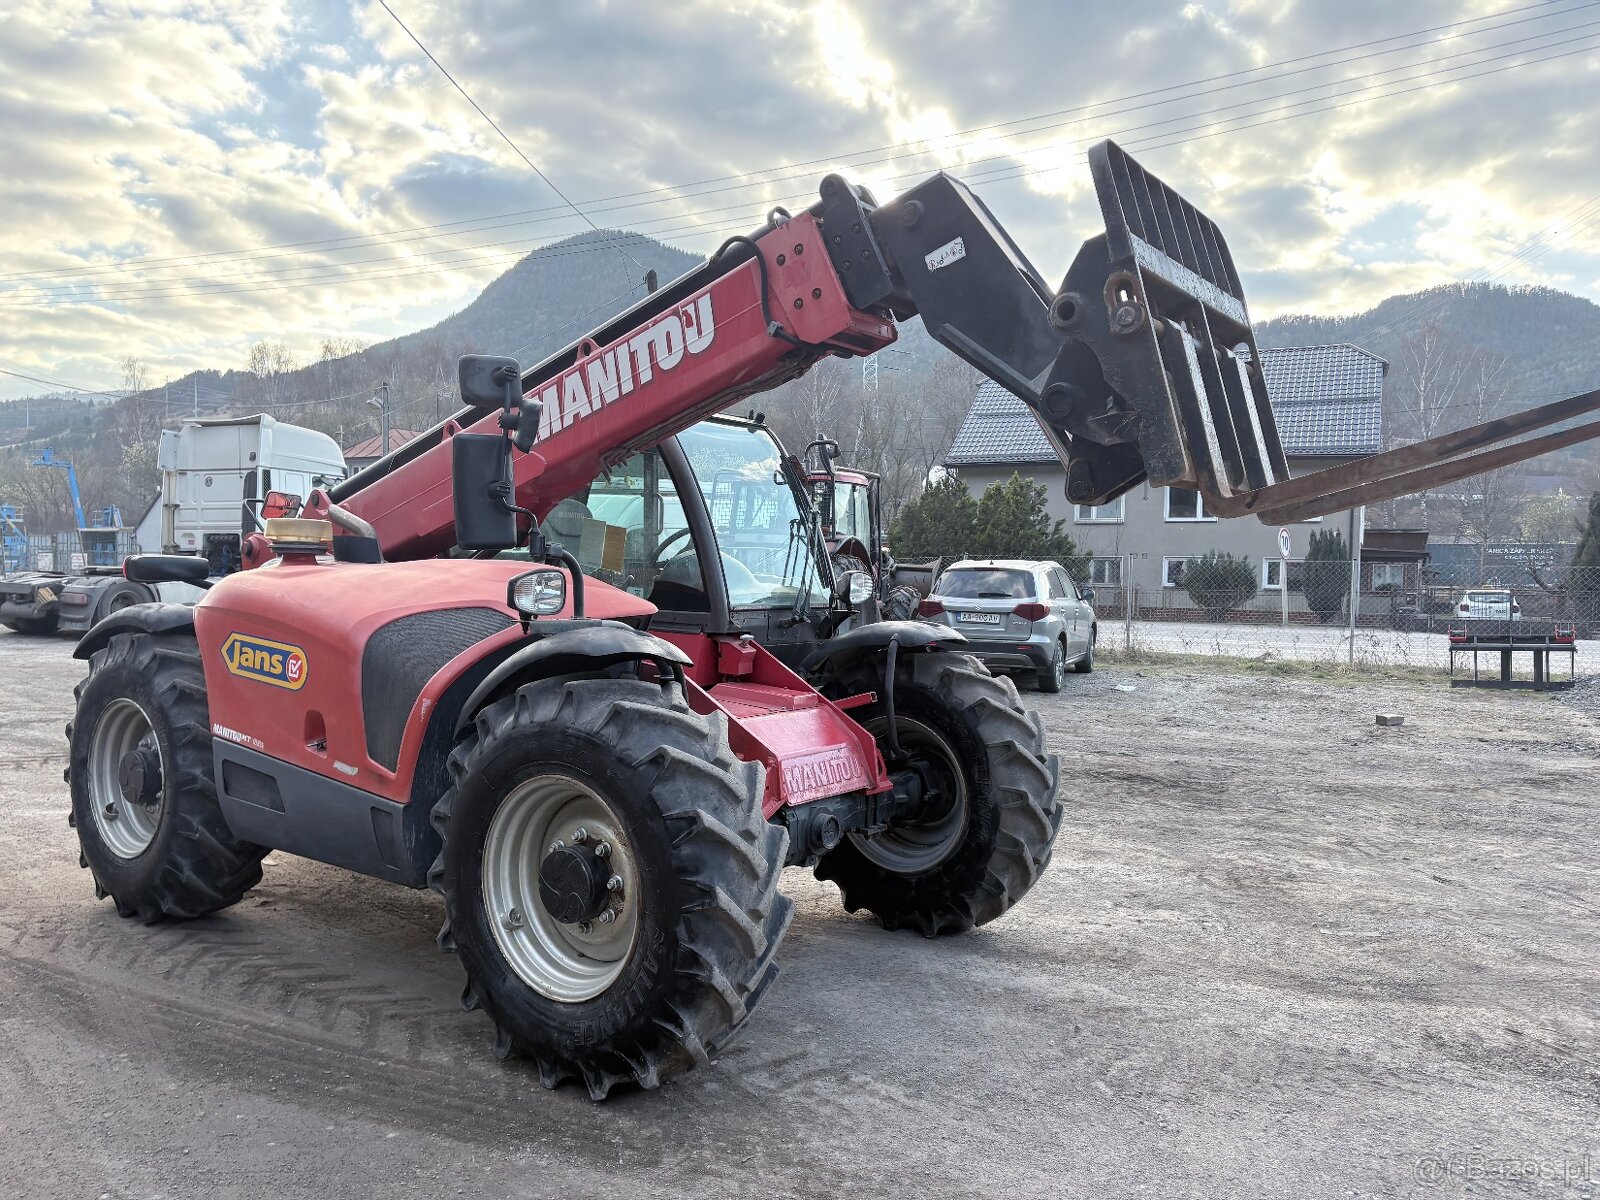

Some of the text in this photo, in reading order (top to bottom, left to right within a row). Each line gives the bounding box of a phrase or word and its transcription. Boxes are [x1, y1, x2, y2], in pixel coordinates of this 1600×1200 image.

[530, 292, 715, 446] MANITOU
[1281, 535, 1289, 551] 10
[230, 641, 283, 675] Jans
[212, 723, 241, 742] MANITOU
[784, 755, 862, 794] MANITOU
